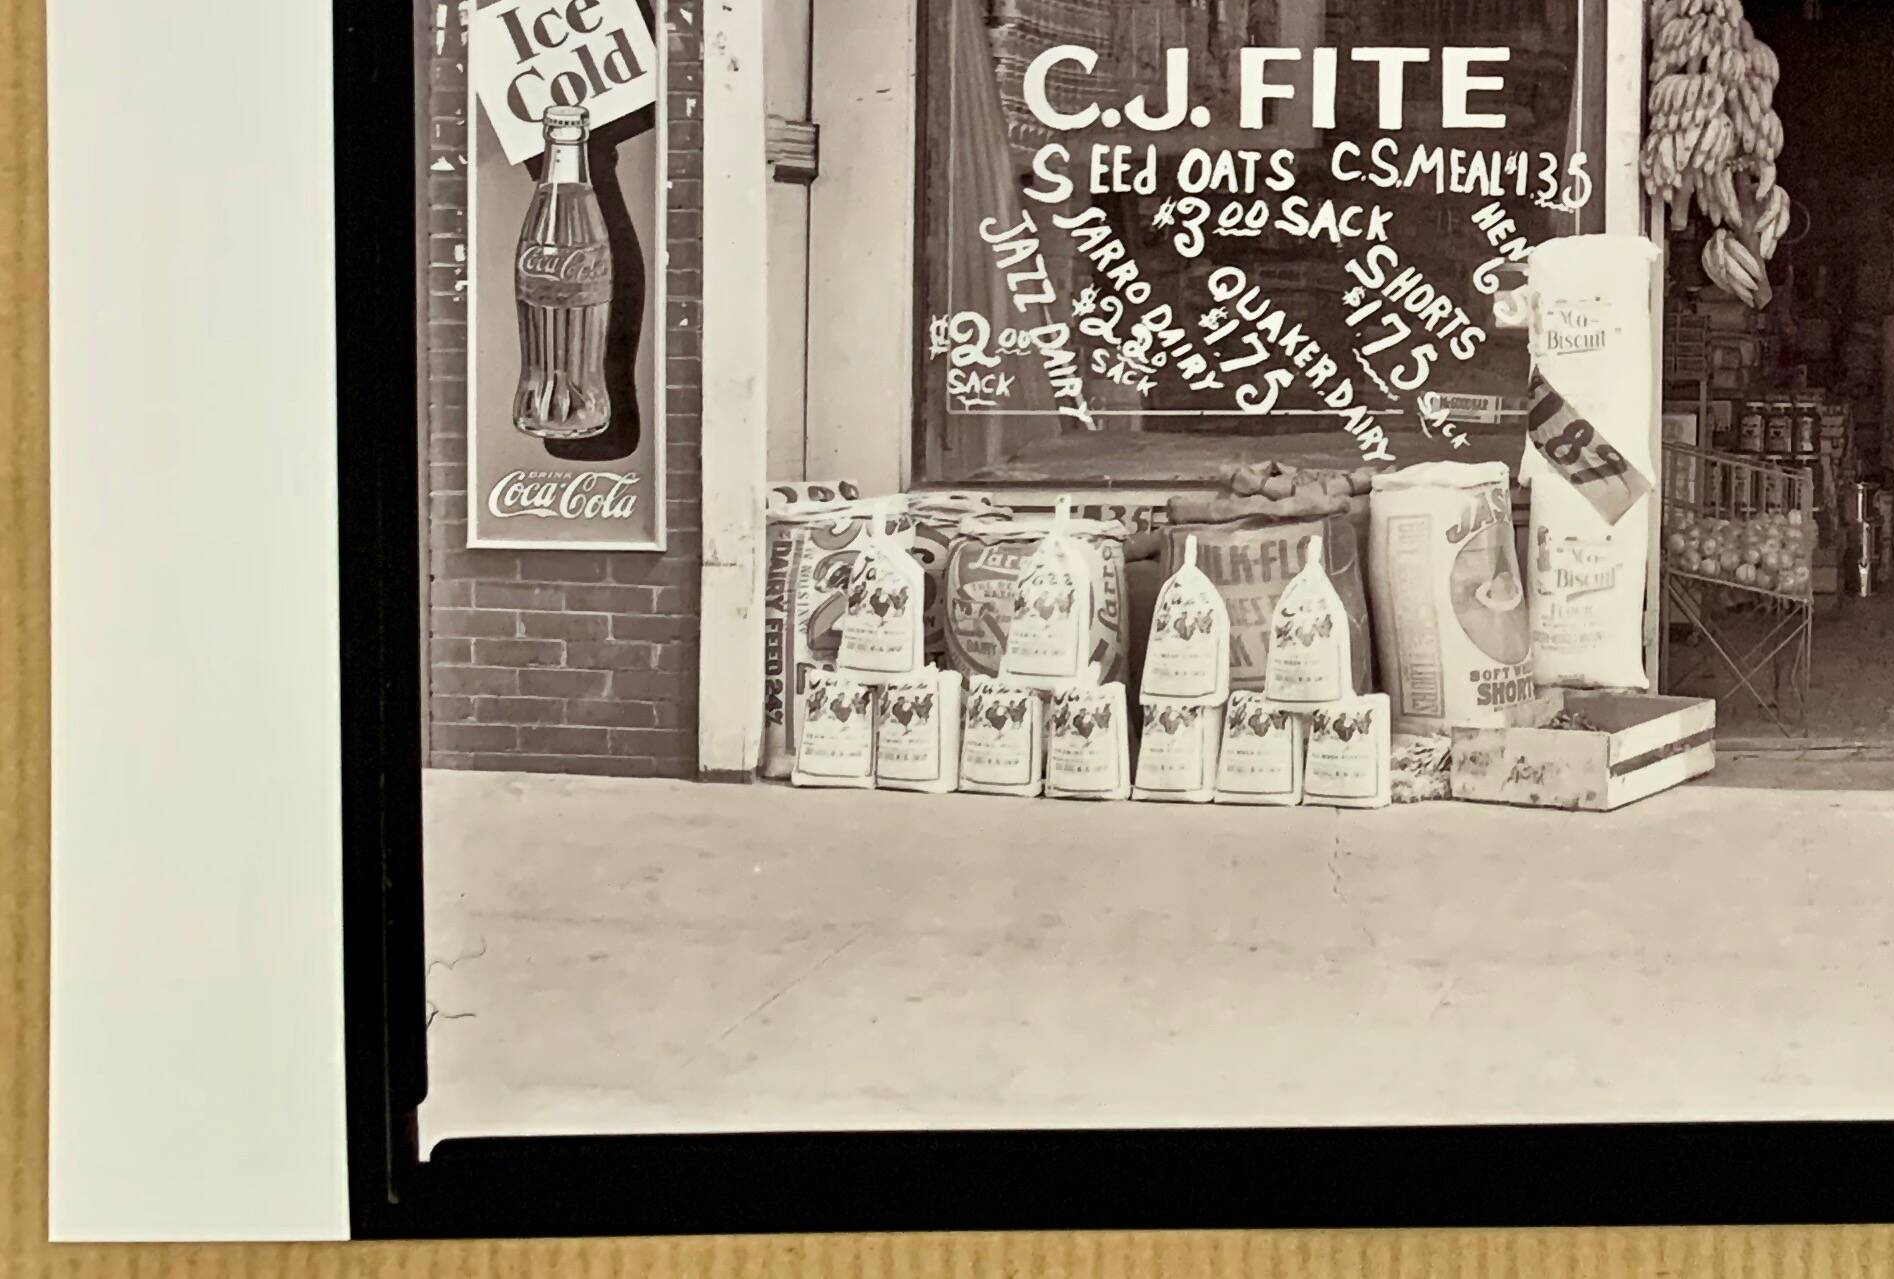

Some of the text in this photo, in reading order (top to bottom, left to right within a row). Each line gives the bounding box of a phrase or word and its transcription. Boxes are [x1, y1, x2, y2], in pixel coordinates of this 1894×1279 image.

[506, 28, 648, 123] Cold
[1022, 44, 1510, 131] C.J. FITE
[1177, 149, 1295, 195] OATS
[1274, 196, 1393, 245] SACK
[978, 209, 1100, 430] JAZZ DAIRY
[1344, 244, 1486, 361] SHORTS
[1091, 349, 1158, 397] SACK
[1141, 303, 1224, 391] DAIRY
[947, 369, 1015, 398] SACK
[1324, 379, 1396, 461] DAIRY
[1418, 391, 1471, 450] SACK
[528, 471, 573, 480] DRINK
[765, 618, 784, 676] FEED
[1470, 668, 1509, 683] SOFT
